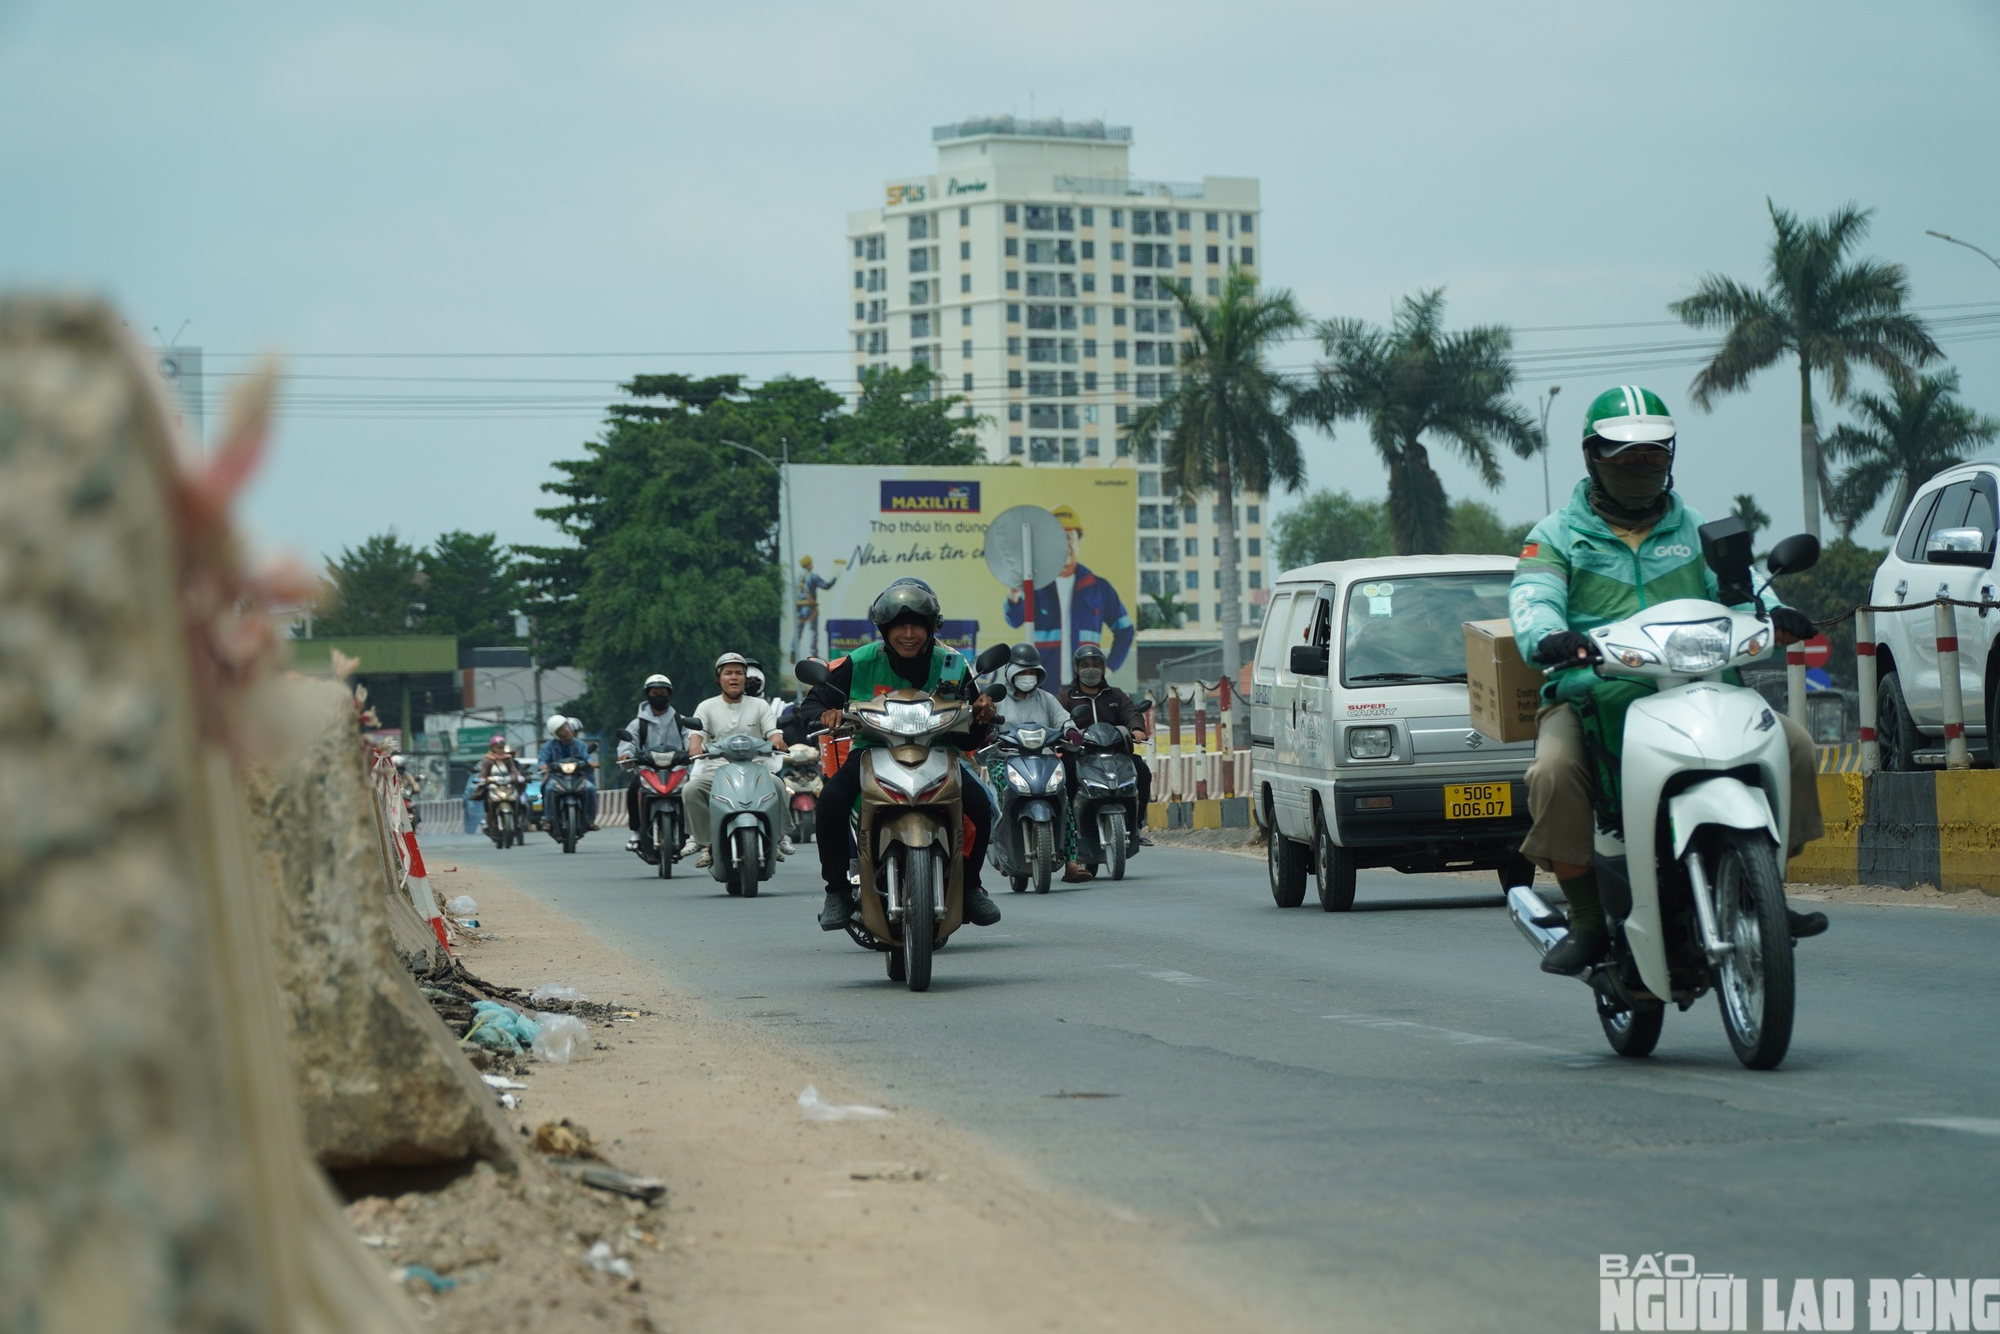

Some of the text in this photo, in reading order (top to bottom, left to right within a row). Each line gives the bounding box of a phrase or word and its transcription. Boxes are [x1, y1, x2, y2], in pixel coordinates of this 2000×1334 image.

[891, 496, 970, 510] MAXILITE
[1347, 708, 1397, 717] CARRY
[1464, 786, 1492, 800] 50G
[1453, 801, 1504, 817] 006.07
